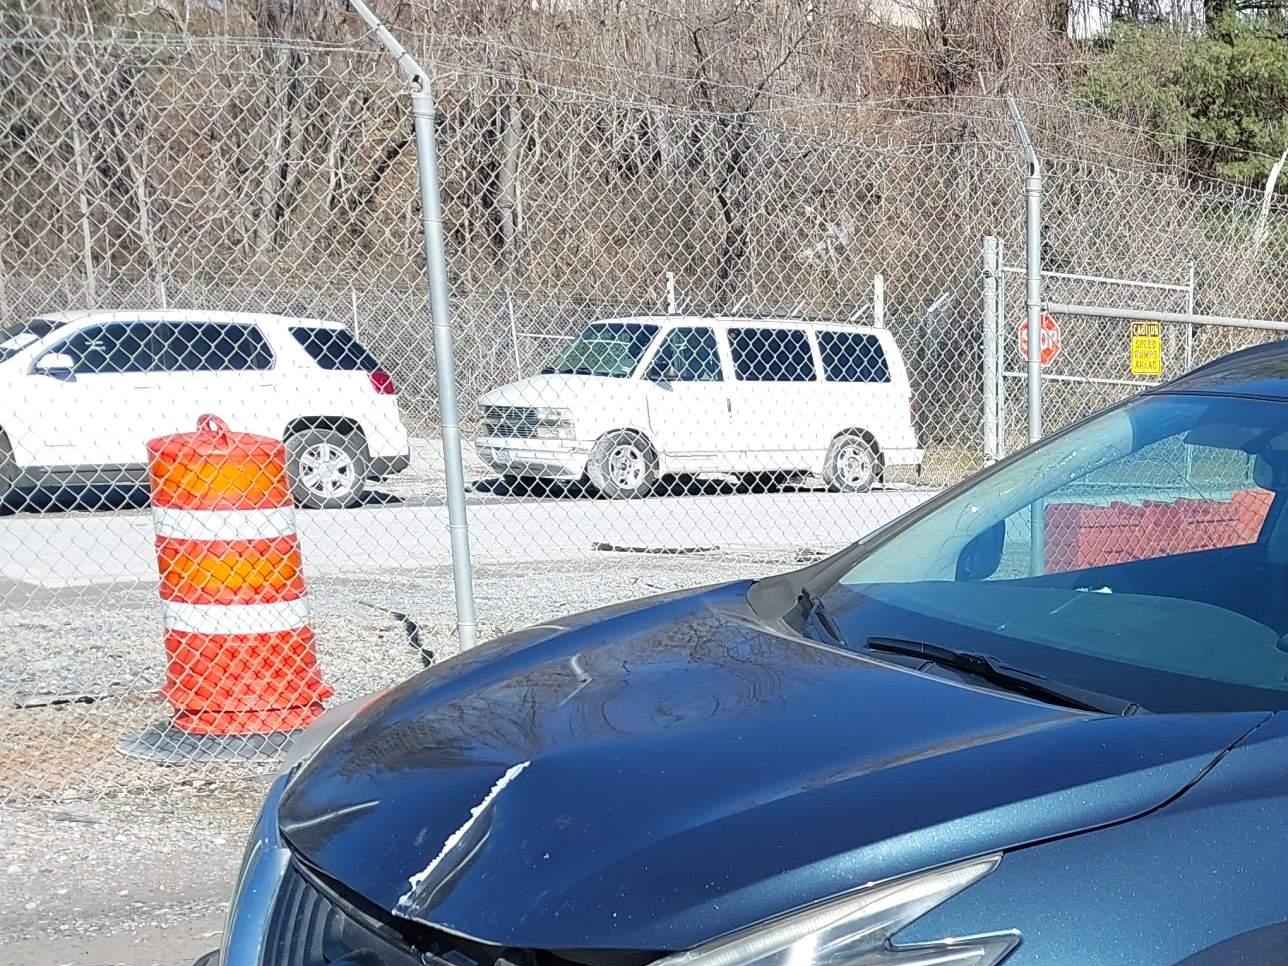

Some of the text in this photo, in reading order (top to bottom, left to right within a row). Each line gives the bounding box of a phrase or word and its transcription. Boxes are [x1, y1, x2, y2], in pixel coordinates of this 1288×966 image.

[1022, 328, 1058, 350] SOP
[1135, 339, 1157, 349] SPEED
[1134, 361, 1157, 370] AHEAD
